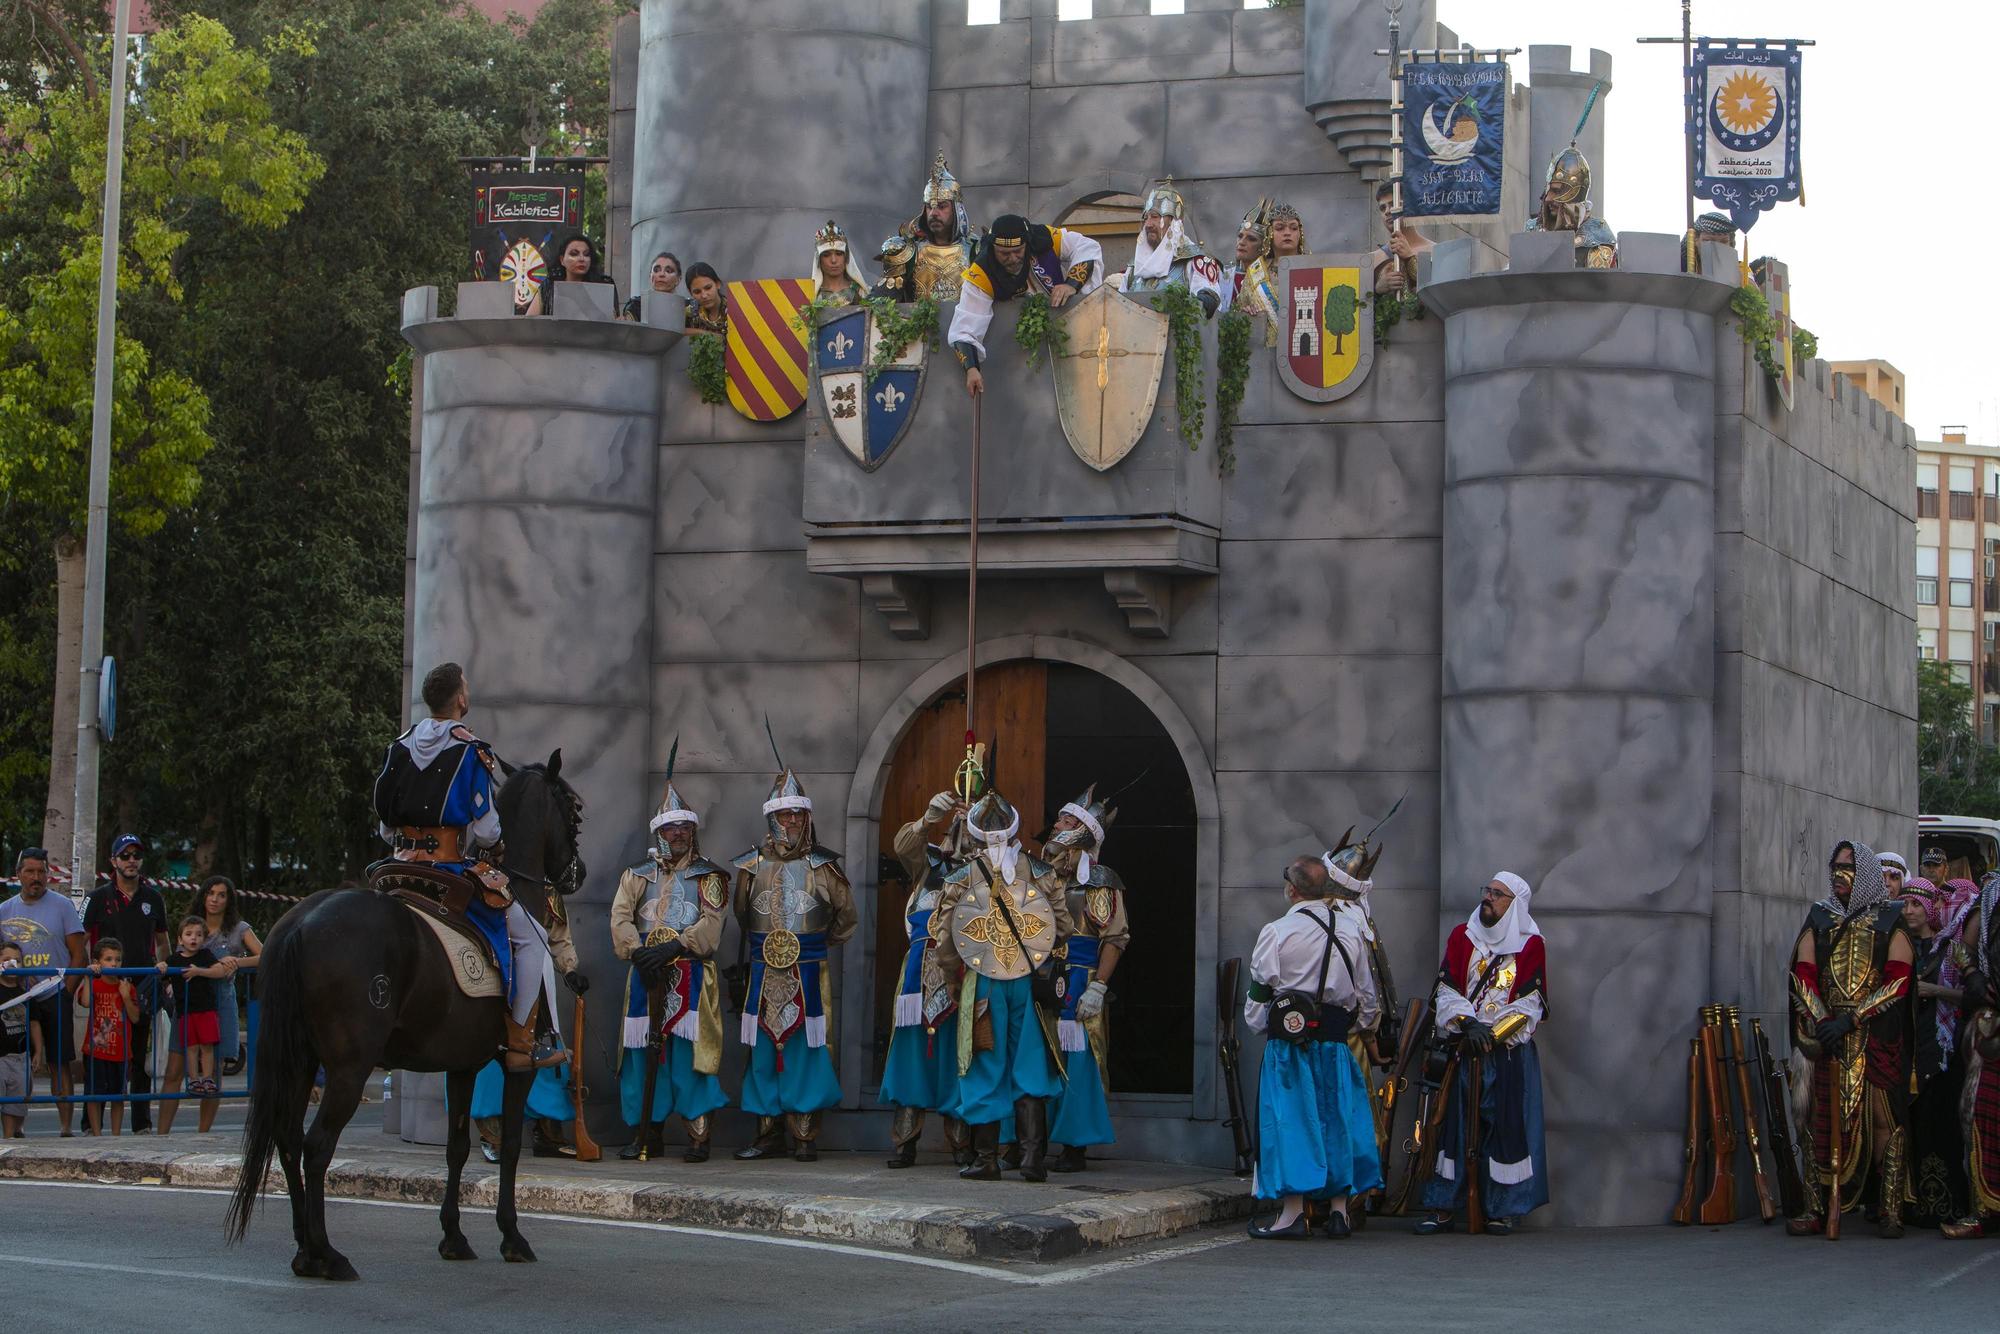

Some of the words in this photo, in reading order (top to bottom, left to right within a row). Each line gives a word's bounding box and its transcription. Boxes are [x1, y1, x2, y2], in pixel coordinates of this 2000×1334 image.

[1718, 156, 1772, 167] abbasidas
[1755, 168, 1772, 176] 2020
[1421, 190, 1485, 205] ALICANTE
[121, 833, 137, 842] FILA
[23, 953, 50, 966] GUY
